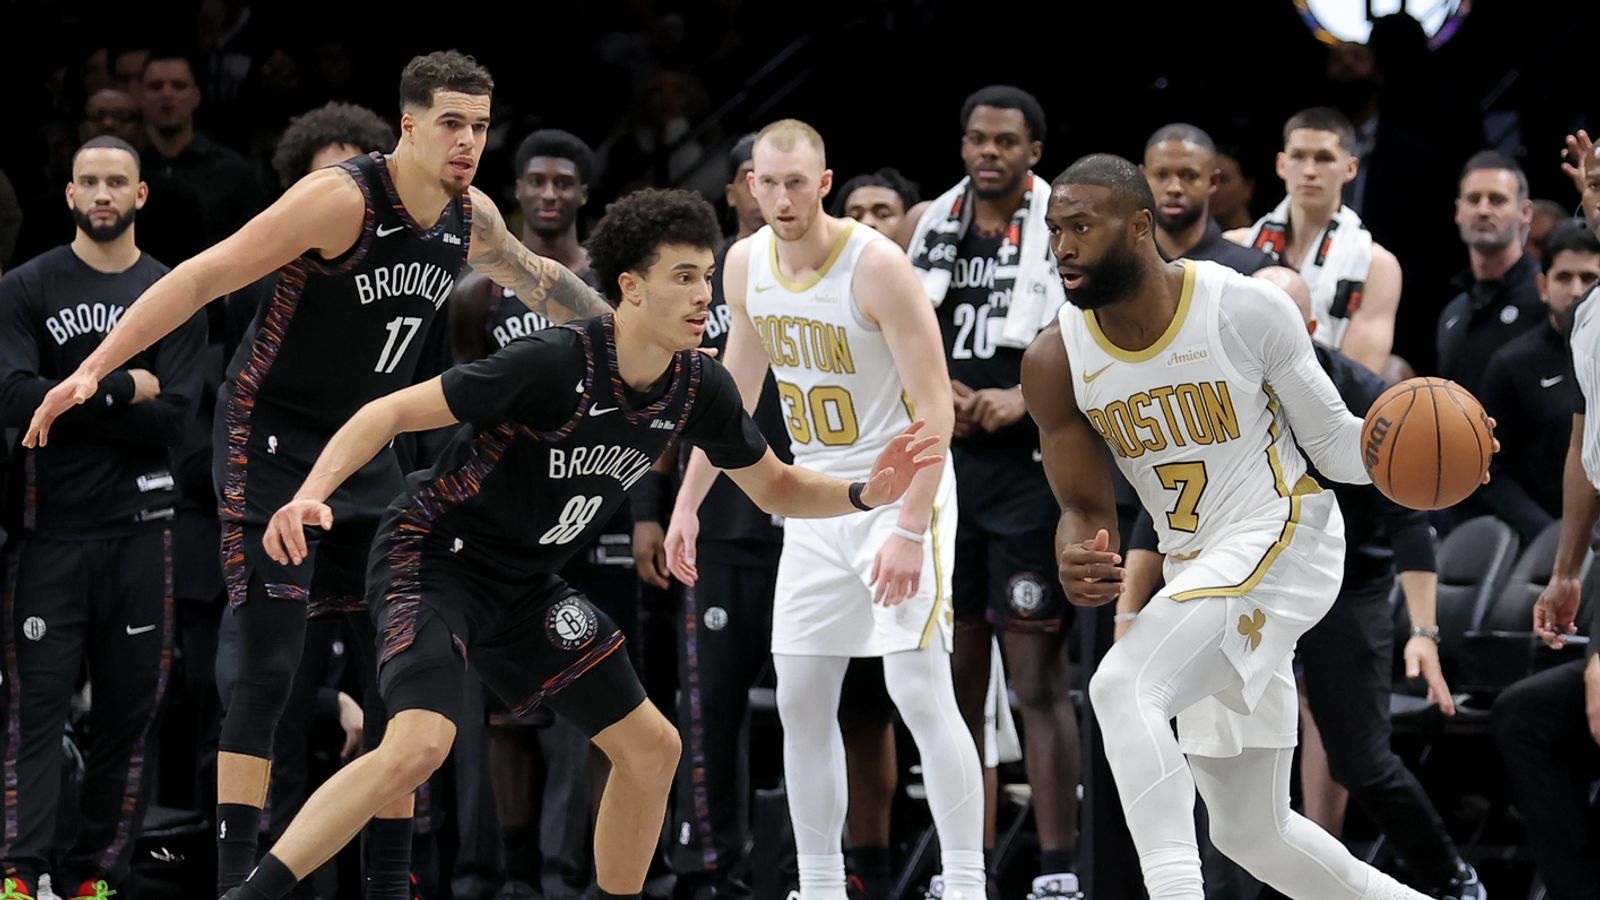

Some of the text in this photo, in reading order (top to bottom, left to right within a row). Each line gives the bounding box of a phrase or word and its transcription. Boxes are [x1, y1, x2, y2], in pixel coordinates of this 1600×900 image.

[354, 262, 454, 311] BROOKLYN
[374, 316, 423, 374] 17
[952, 303, 997, 359] 20
[1167, 349, 1208, 366] Amica
[777, 380, 859, 446] 30
[1086, 380, 1241, 459] BOSTON
[549, 444, 652, 491] BROOKLYN
[538, 495, 603, 545] 88
[1152, 460, 1208, 533] 7
[561, 611, 582, 636] B
